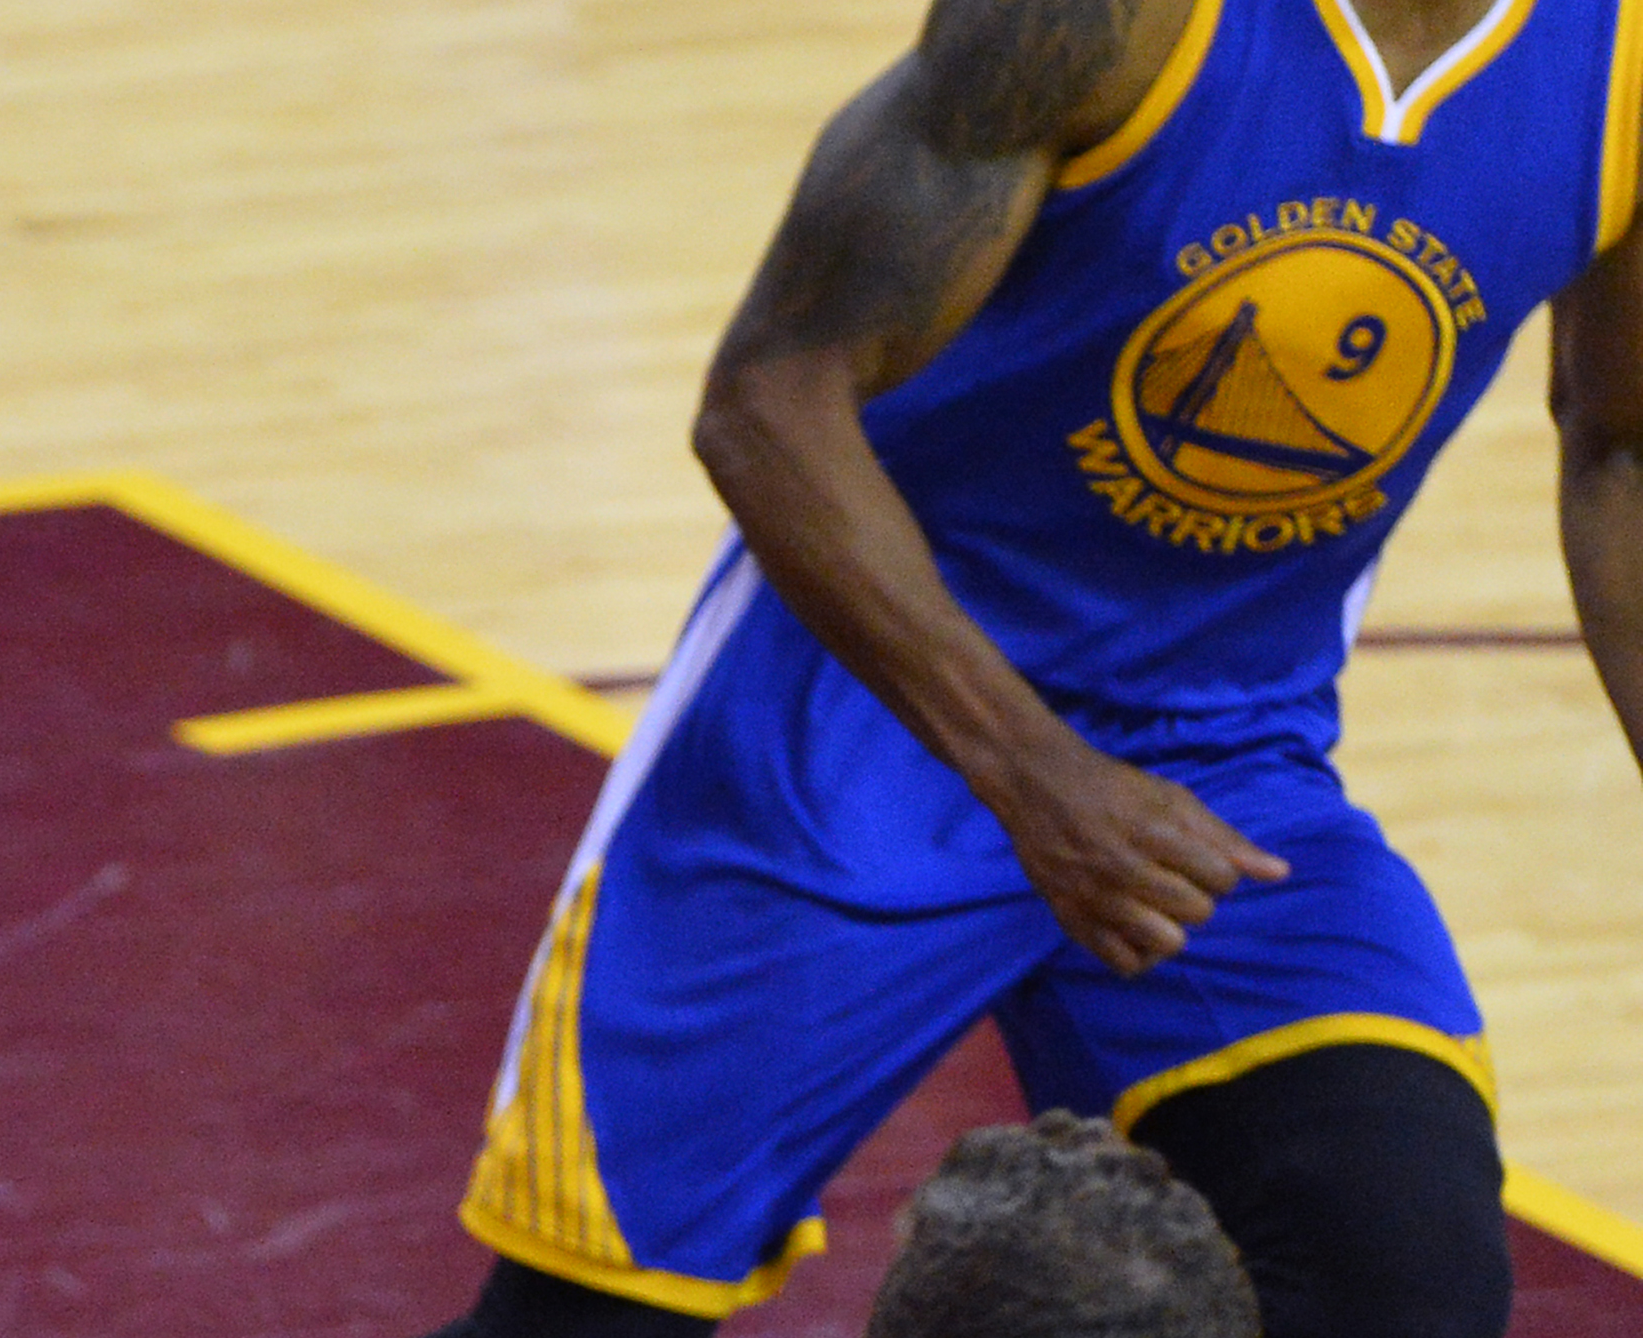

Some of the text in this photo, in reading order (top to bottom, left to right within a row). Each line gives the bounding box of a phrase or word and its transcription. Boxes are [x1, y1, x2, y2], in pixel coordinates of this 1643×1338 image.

[1175, 197, 1489, 332] GOLDEN STATE
[1323, 314, 1389, 382] 9
[1066, 419, 1389, 556] WARRIORS
